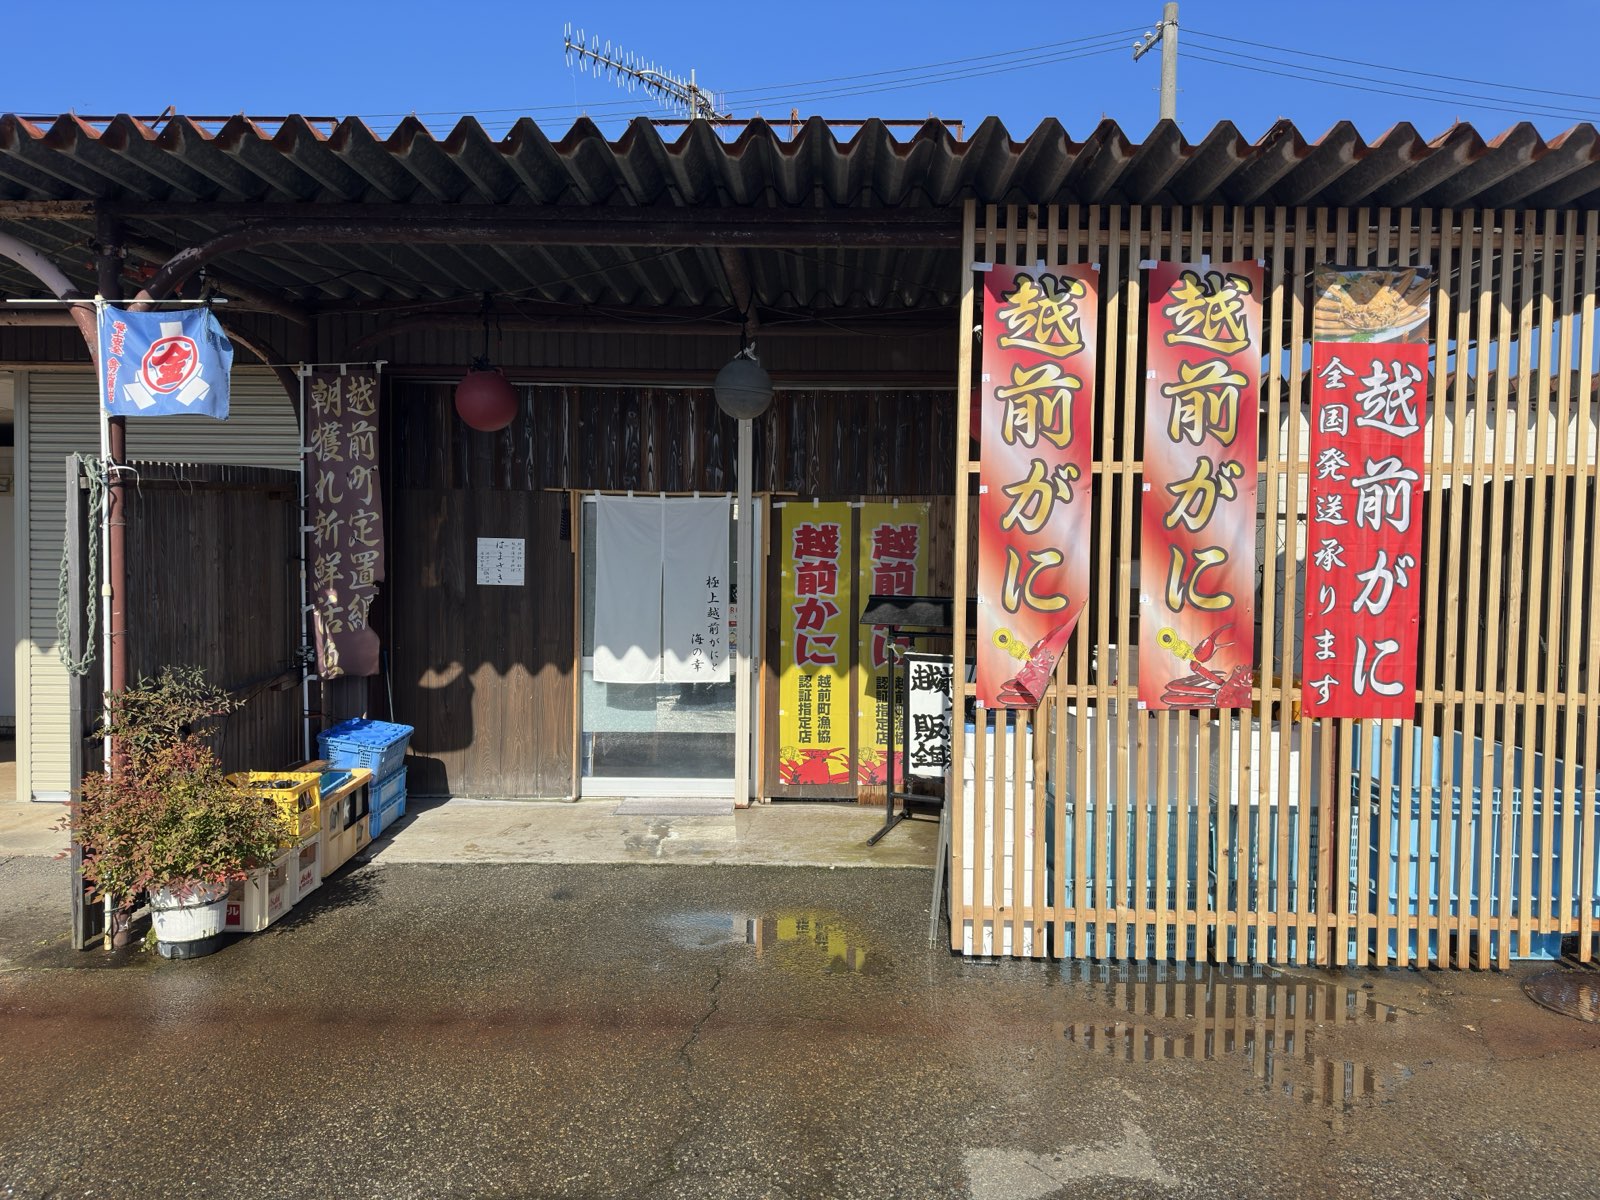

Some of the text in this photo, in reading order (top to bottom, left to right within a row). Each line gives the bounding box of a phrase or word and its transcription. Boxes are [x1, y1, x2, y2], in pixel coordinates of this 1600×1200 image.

[994, 271, 1086, 613] 越前がに
[1160, 270, 1252, 612] 越前がに
[793, 523, 841, 666] 越前かに
[1310, 356, 1356, 706] 全国発送承ります
[1351, 360, 1422, 698] 越前がに
[691, 633, 704, 672] 海の幸
[706, 575, 720, 672] 極上越前がにと
[798, 674, 812, 744] 認証指定店
[817, 674, 831, 744] 越前町漁協
